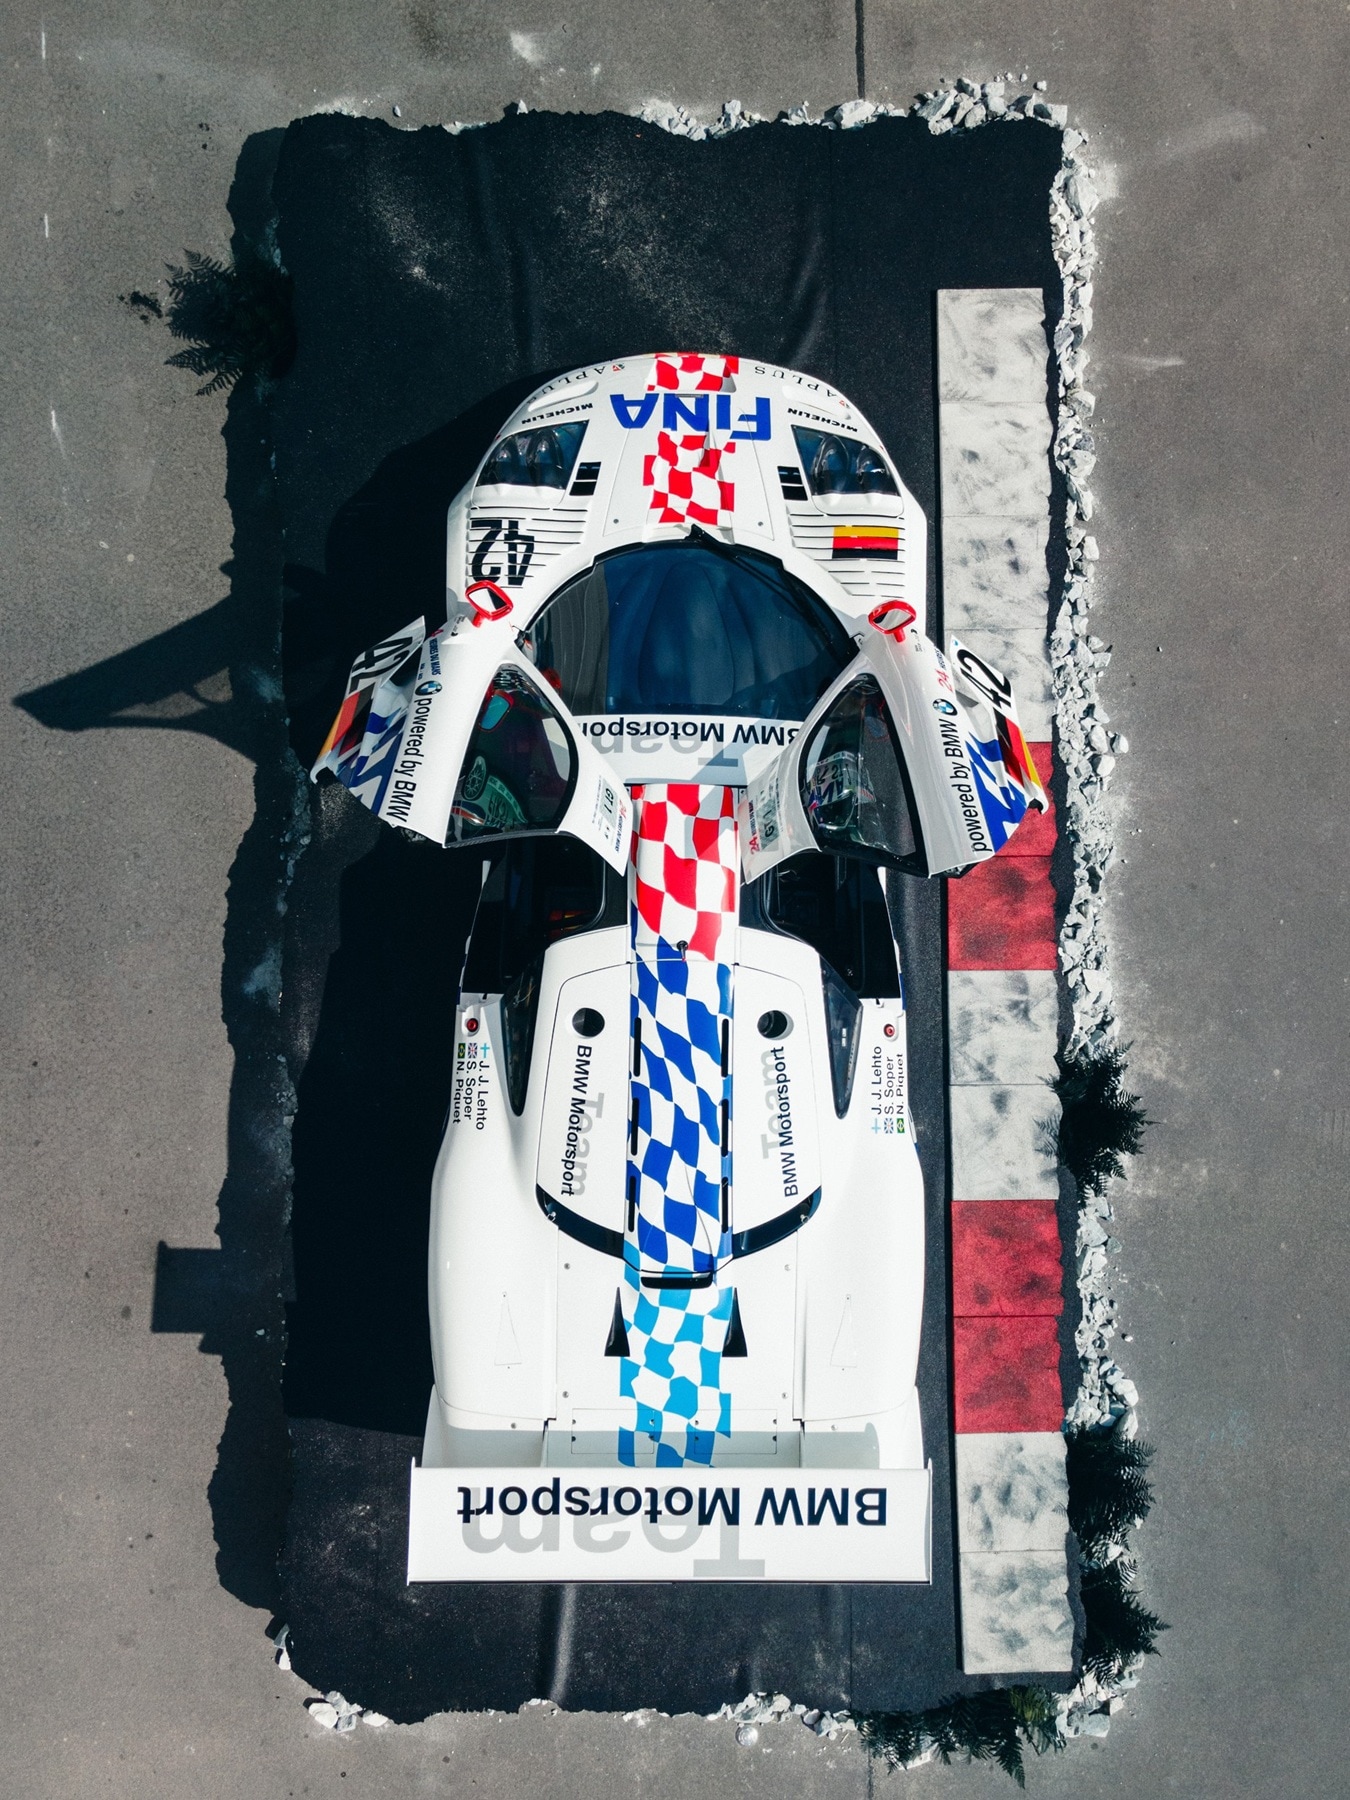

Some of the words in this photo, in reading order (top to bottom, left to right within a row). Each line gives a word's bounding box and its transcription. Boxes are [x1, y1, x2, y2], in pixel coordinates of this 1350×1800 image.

[755, 365, 837, 398] APLUS
[521, 402, 593, 425] MICHELIN
[610, 392, 772, 441] FINA
[787, 407, 858, 433] MICHELIN
[470, 519, 535, 586] 42
[349, 636, 413, 695] 42
[957, 649, 1012, 710] 42
[406, 697, 433, 757] powered
[582, 717, 725, 743] Motorspor
[938, 718, 964, 759] BMW
[395, 756, 424, 778] by
[950, 760, 972, 782] by
[386, 780, 417, 823] BMW
[952, 783, 993, 852] powered
[456, 1061, 466, 1075] N.
[466, 1061, 477, 1075] S.
[573, 1044, 593, 1095] BMW
[871, 1046, 882, 1085] Lehto
[884, 1056, 896, 1098] Soper
[896, 1053, 905, 1097] Piquet
[452, 1078, 464, 1124] Piquet
[463, 1078, 476, 1121] Soper
[475, 1090, 489, 1131] Lehto
[760, 1049, 783, 1160] Team
[770, 1046, 794, 1148] Motorsport
[884, 1100, 895, 1115] S.
[896, 1100, 904, 1115] N.
[561, 1096, 586, 1197] Motorsport
[569, 1092, 605, 1196] Team
[780, 1151, 799, 1198] BMW
[456, 1476, 741, 1527] Motorsport
[754, 1487, 888, 1527] BMW
[461, 1484, 766, 1577] Team
